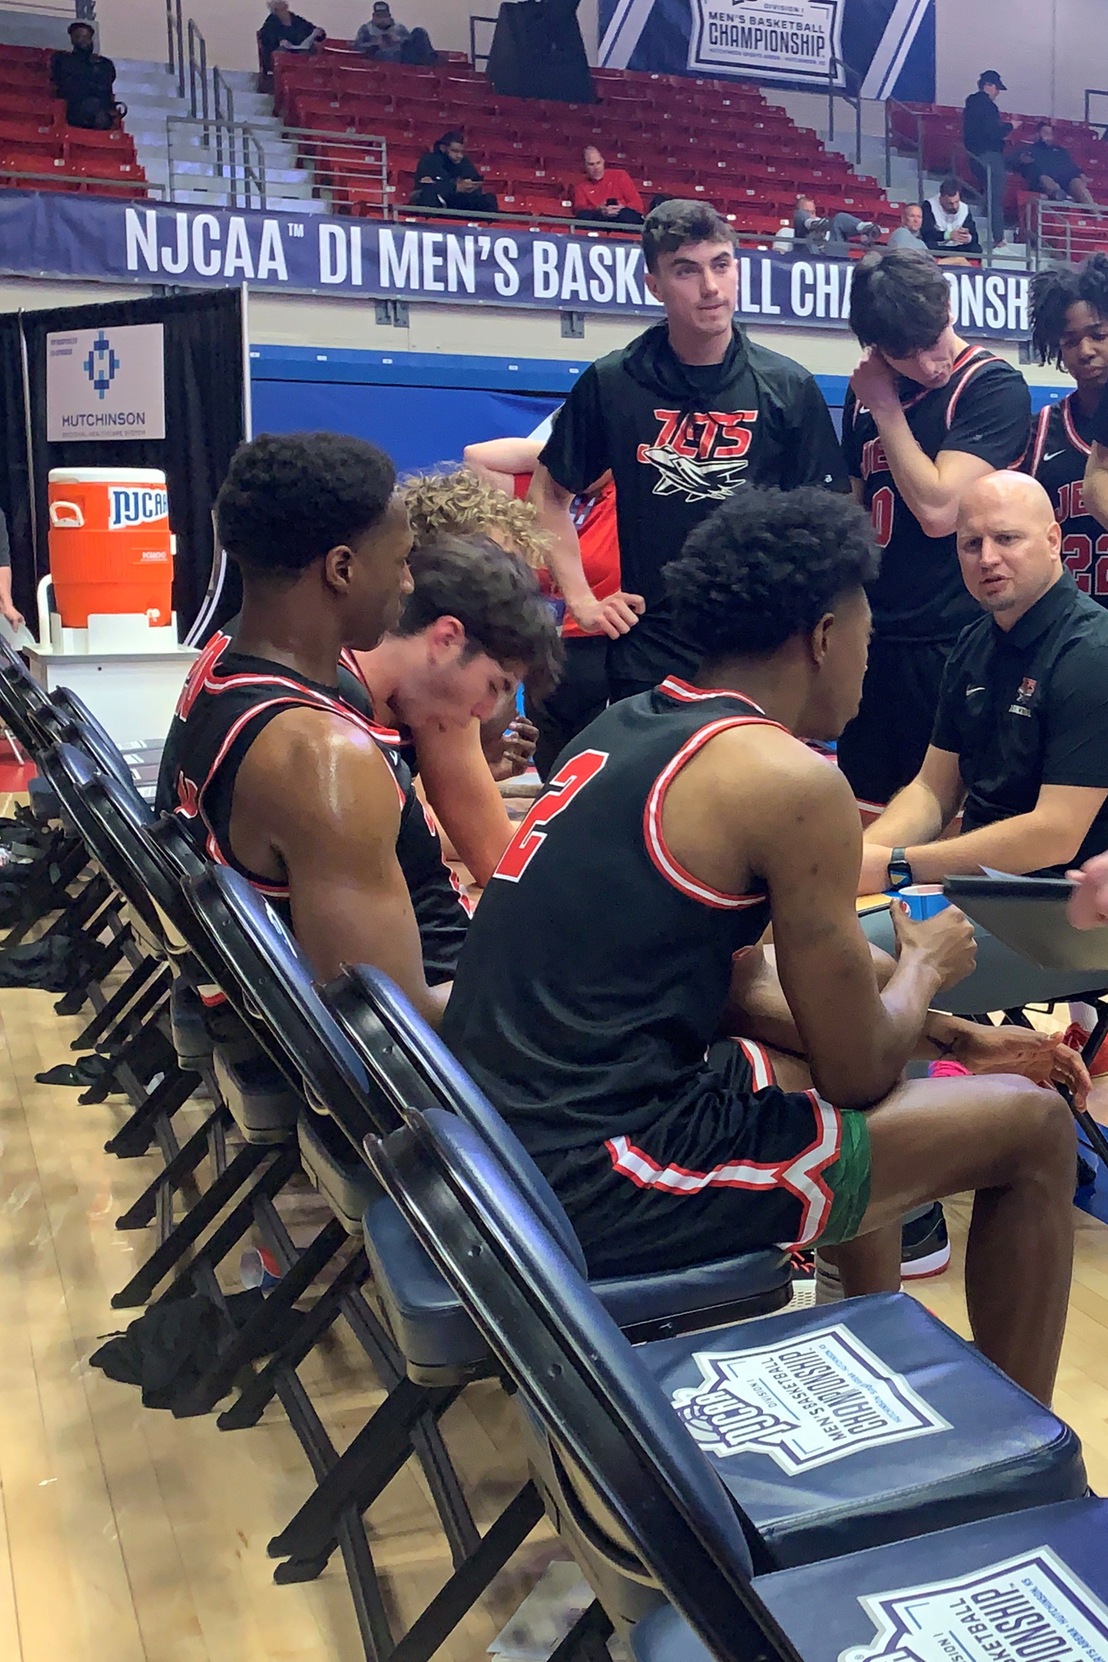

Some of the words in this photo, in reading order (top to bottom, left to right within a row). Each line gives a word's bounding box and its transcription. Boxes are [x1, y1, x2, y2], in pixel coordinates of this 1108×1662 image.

[708, 12, 745, 24] MEN'S
[749, 16, 825, 34] BASKETBALL
[709, 23, 825, 58] CHAMPIONSHIP
[318, 223, 363, 286] DI
[378, 228, 520, 297] MEN'S
[62, 412, 146, 427] HUTCHINSON
[637, 409, 759, 464] JETS
[492, 748, 609, 883] 2
[750, 1382, 778, 1408] DIVISION
[761, 1357, 818, 1409] BASKETBALL
[695, 1390, 793, 1446] NJCAA
[809, 1407, 847, 1441] MEN'S
